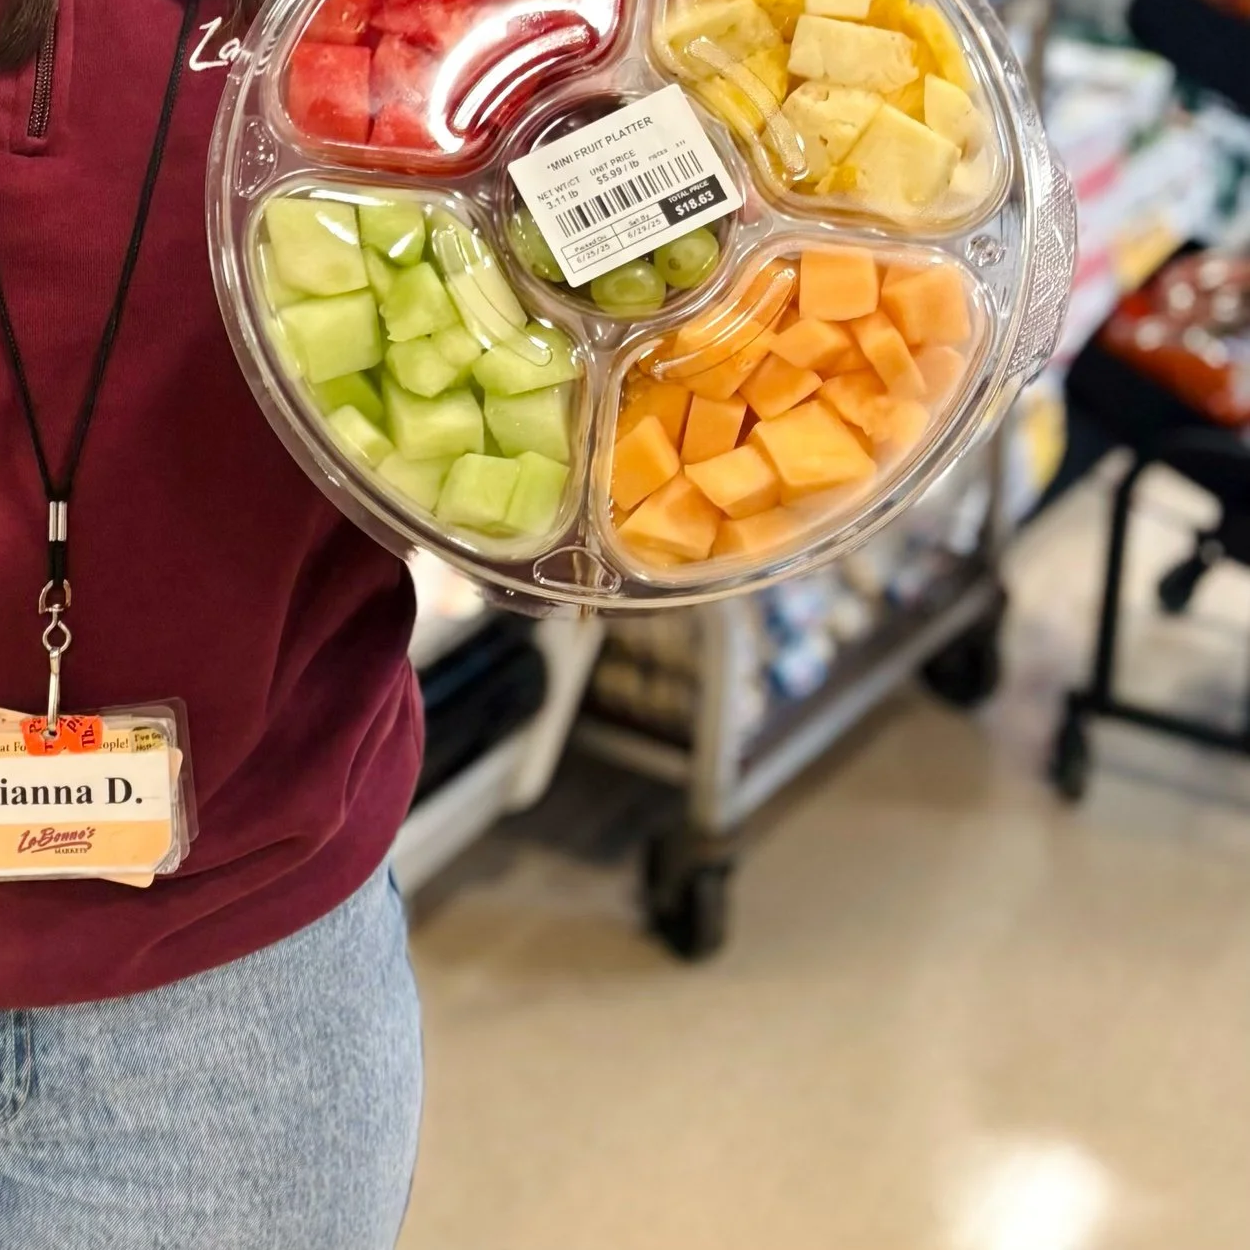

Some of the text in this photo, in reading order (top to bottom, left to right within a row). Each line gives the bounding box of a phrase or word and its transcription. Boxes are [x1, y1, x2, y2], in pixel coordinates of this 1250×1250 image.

[573, 139, 605, 159] FRUIT
[604, 116, 653, 144] PLATTER
[589, 149, 636, 176] UNIT PRICE
[595, 166, 623, 185] $5.99
[628, 158, 640, 169] lb
[536, 176, 580, 202] NET WT/CT
[545, 188, 579, 210] 3.11 lb
[668, 180, 709, 203] TOTAL PRICE
[674, 189, 715, 216] $18.63
[105, 776, 143, 805] D.
[17, 826, 96, 853] LaBonne's
